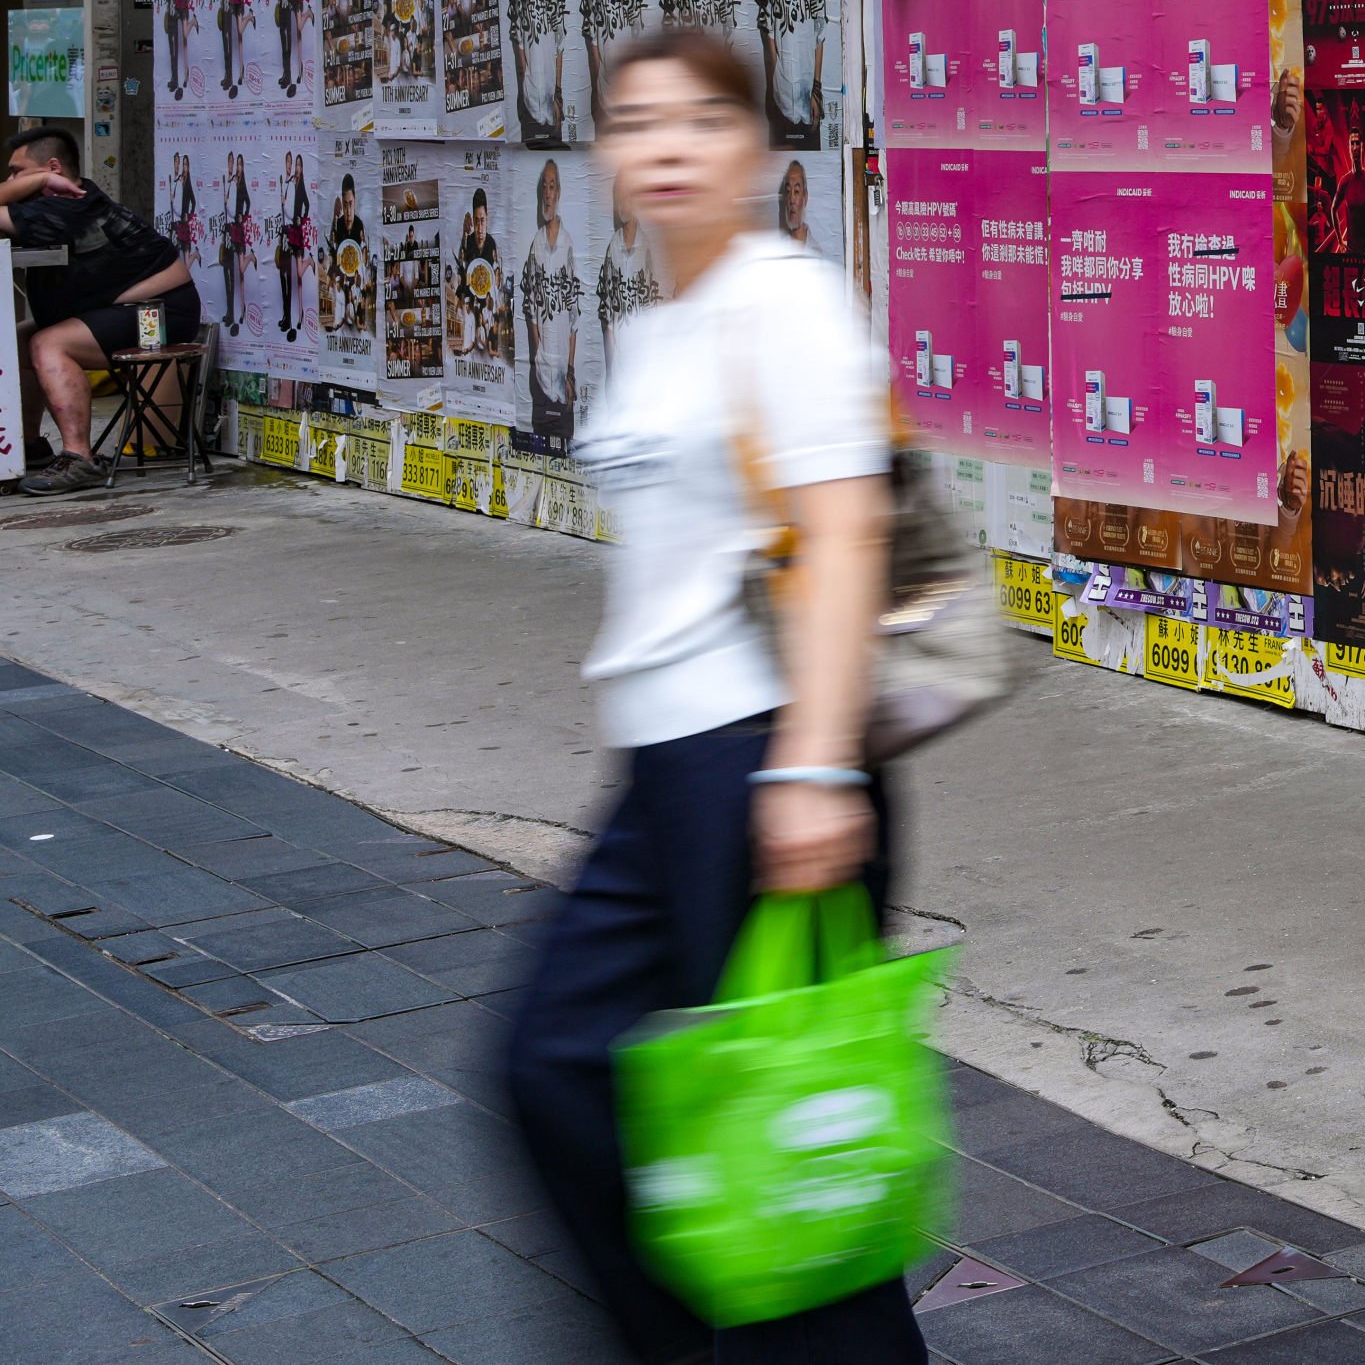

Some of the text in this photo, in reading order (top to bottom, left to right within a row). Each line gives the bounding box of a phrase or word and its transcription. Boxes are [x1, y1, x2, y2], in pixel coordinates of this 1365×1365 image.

[387, 359, 411, 377] SUMMER
[266, 434, 284, 454] 6333
[419, 466, 439, 487] 8171
[1217, 629, 1259, 654] 林先生
[1152, 644, 1189, 674] 6099
